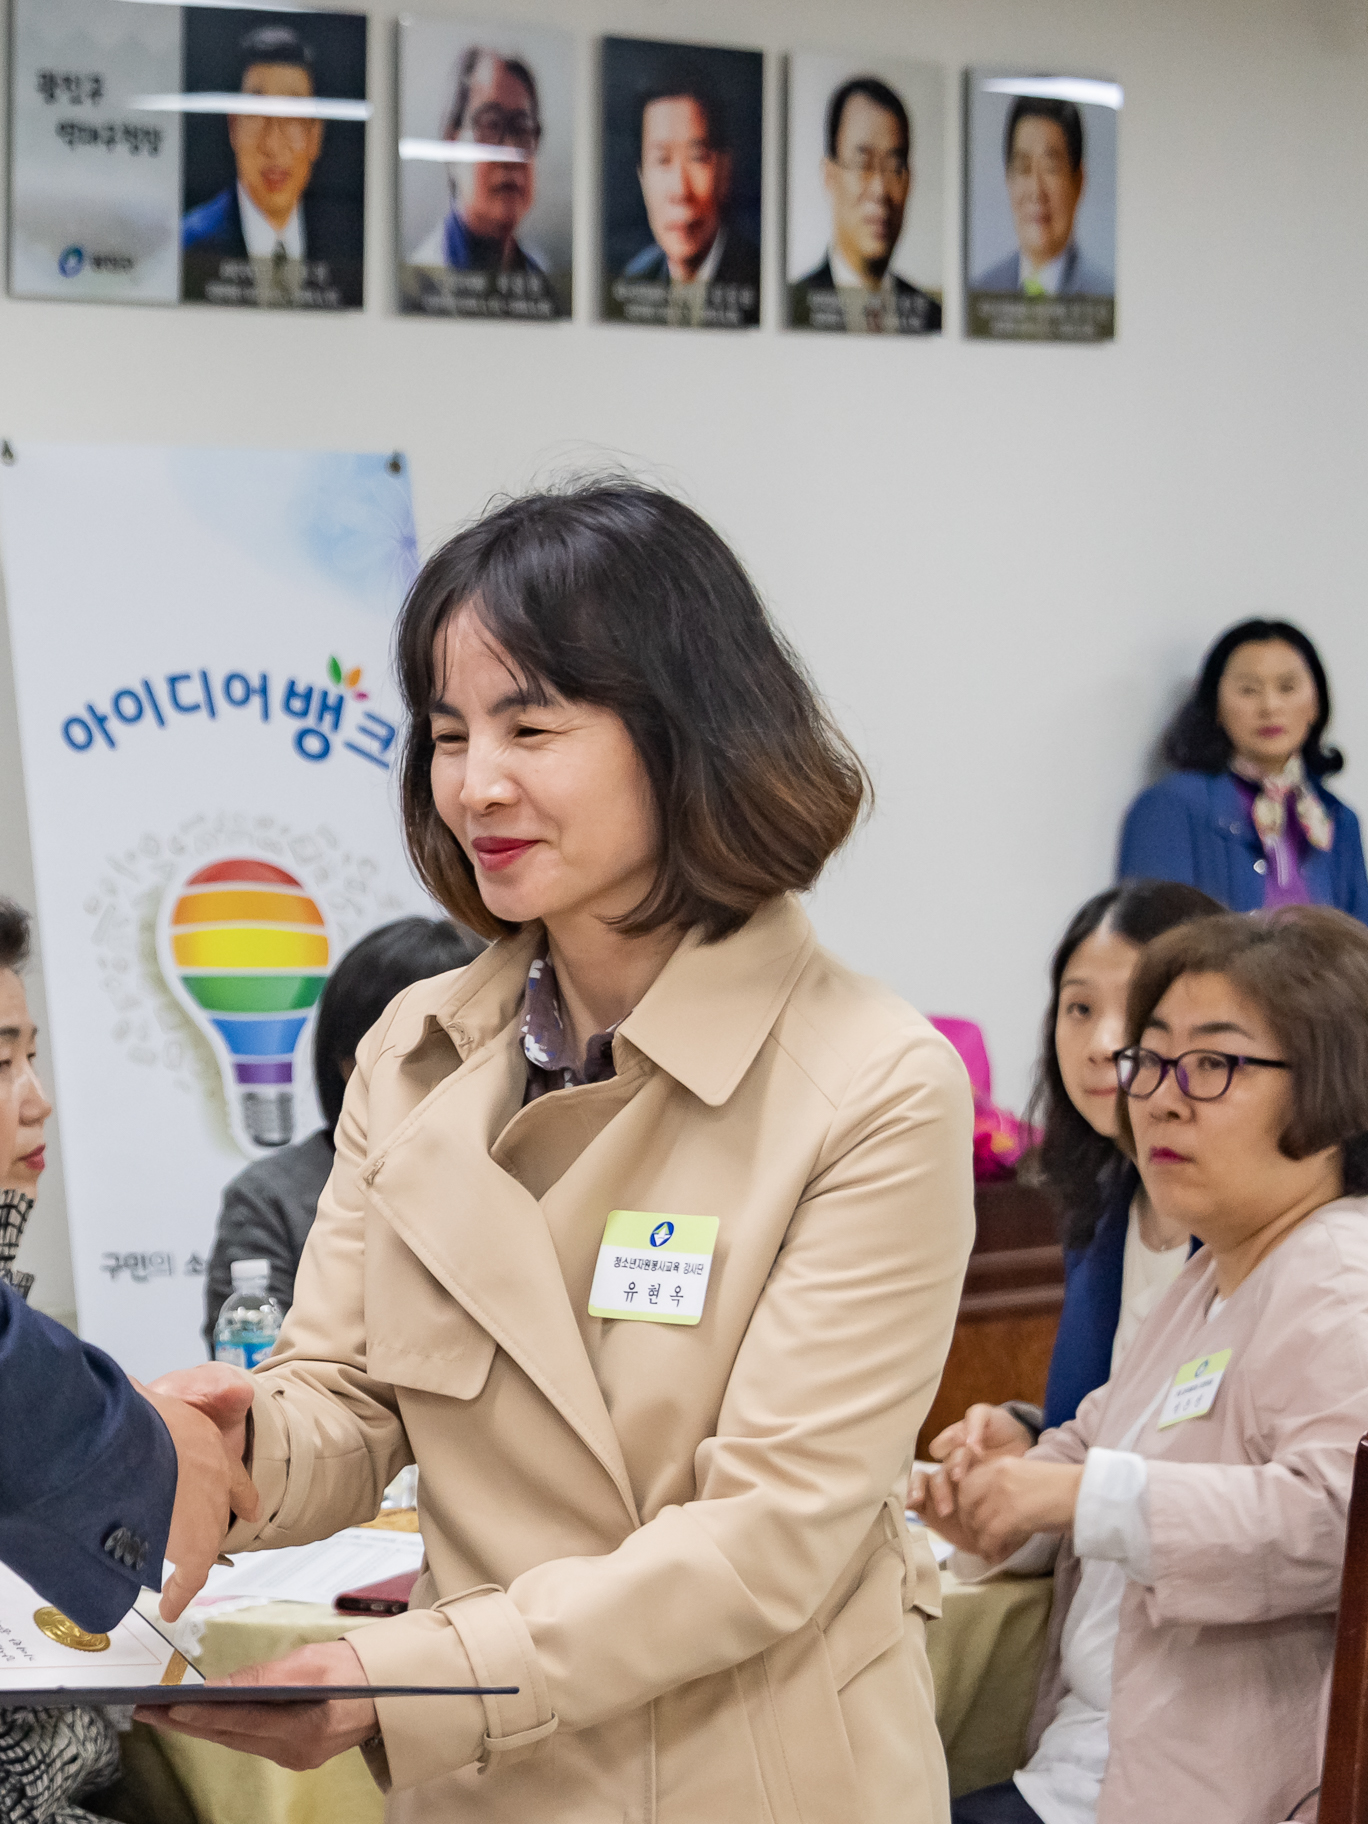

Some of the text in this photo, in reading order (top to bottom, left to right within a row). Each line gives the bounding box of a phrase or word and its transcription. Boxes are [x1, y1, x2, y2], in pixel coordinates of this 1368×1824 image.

[36, 69, 105, 106] 광진구
[61, 668, 398, 770] 아이디어뱅크
[100, 1251, 173, 1284] 구민의
[614, 1256, 705, 1276] 청소년자원봉사교육 강사단
